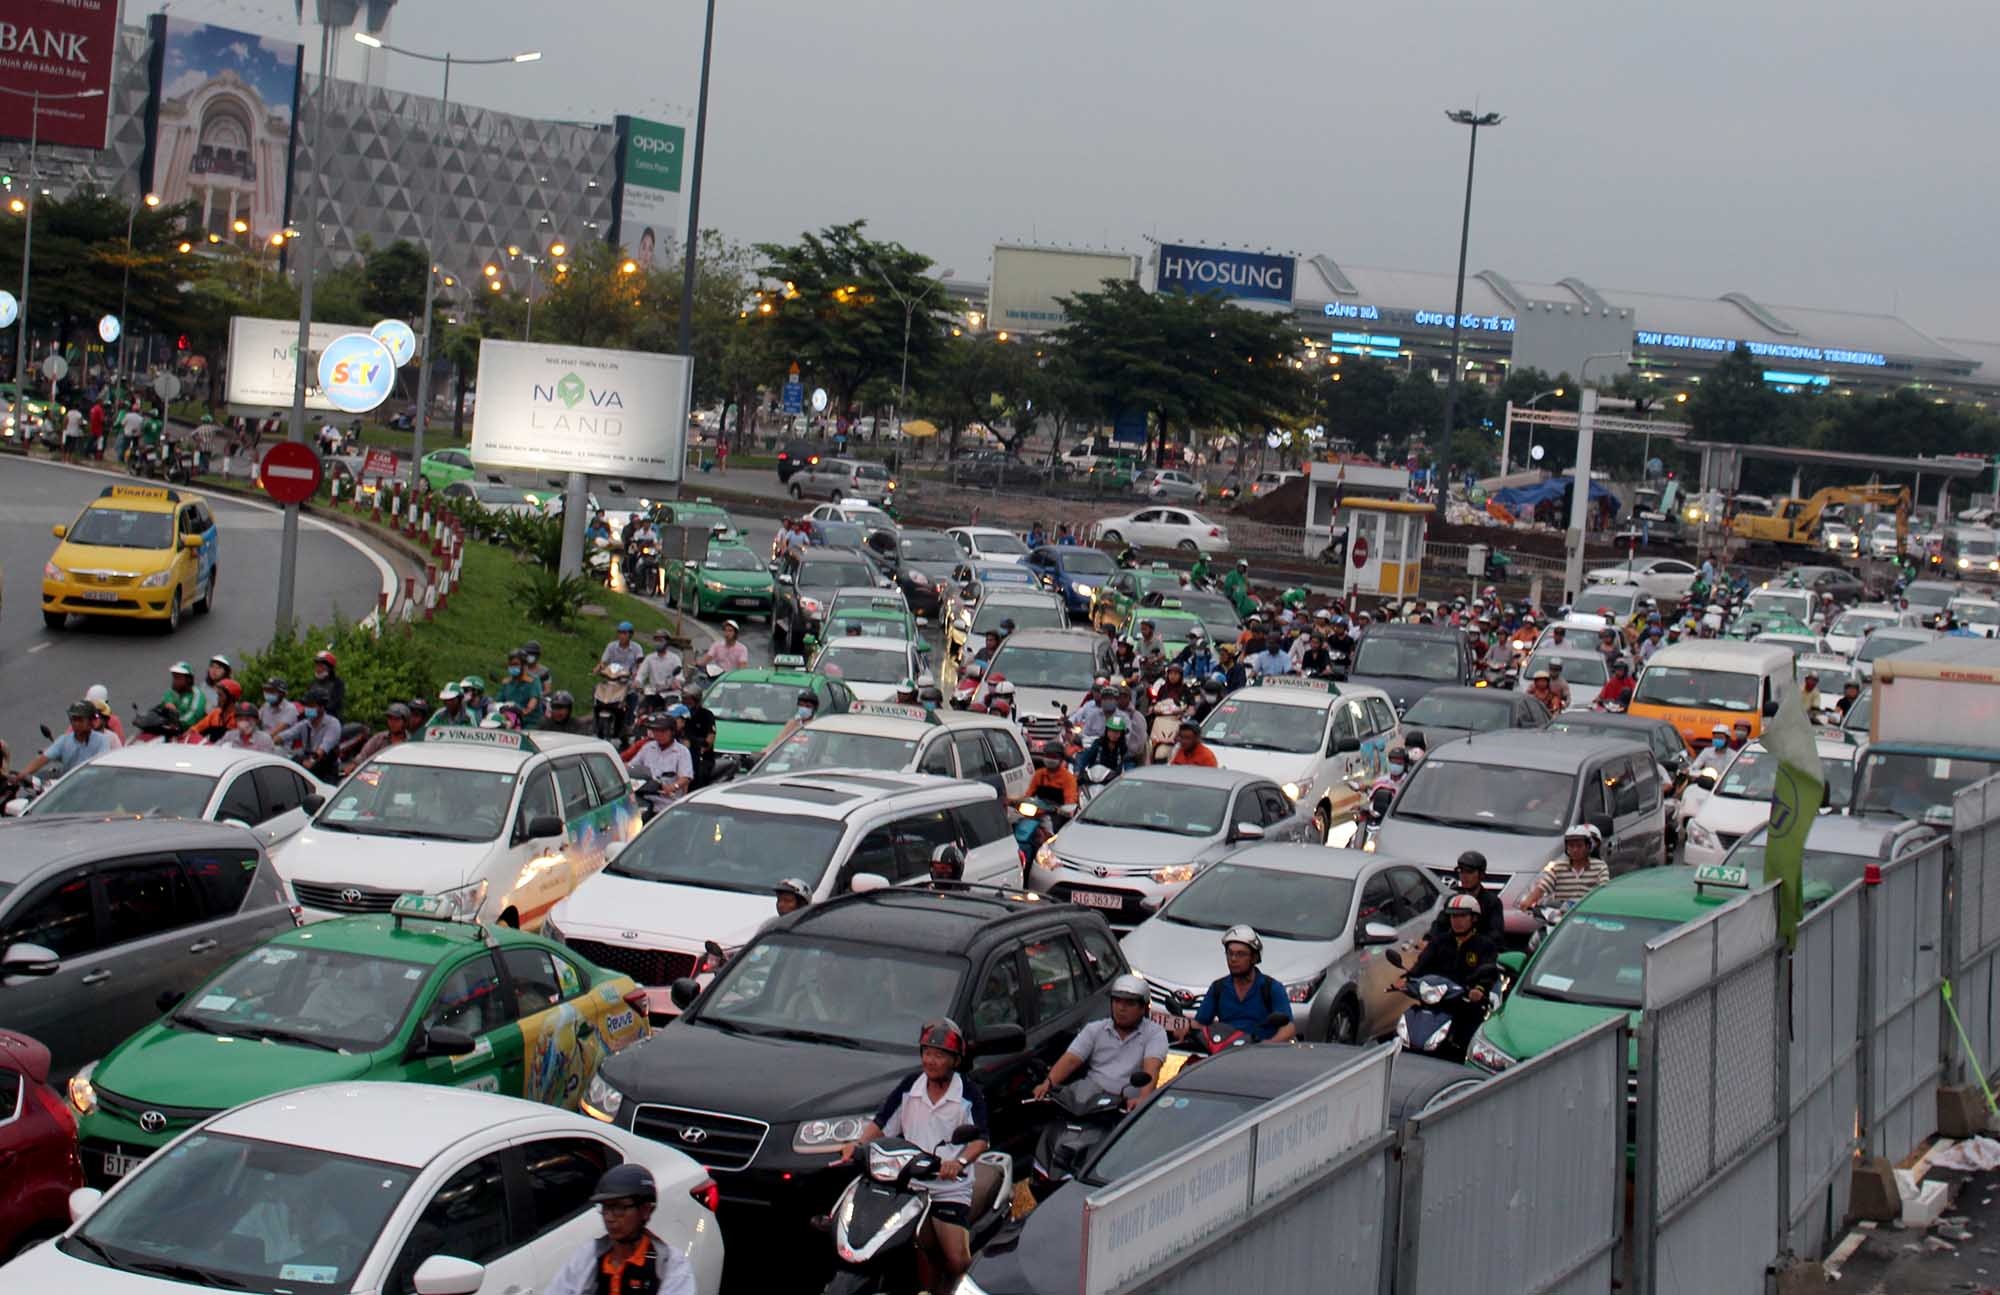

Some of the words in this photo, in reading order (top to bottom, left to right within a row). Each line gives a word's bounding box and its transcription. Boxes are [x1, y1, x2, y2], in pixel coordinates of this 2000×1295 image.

[0, 22, 89, 63] BANK
[1165, 257, 1282, 290] HYOSUNG
[531, 411, 623, 438] LAND
[497, 733, 519, 745] TAXI
[1699, 867, 1741, 882] TAXI
[606, 1010, 633, 1034] Revive
